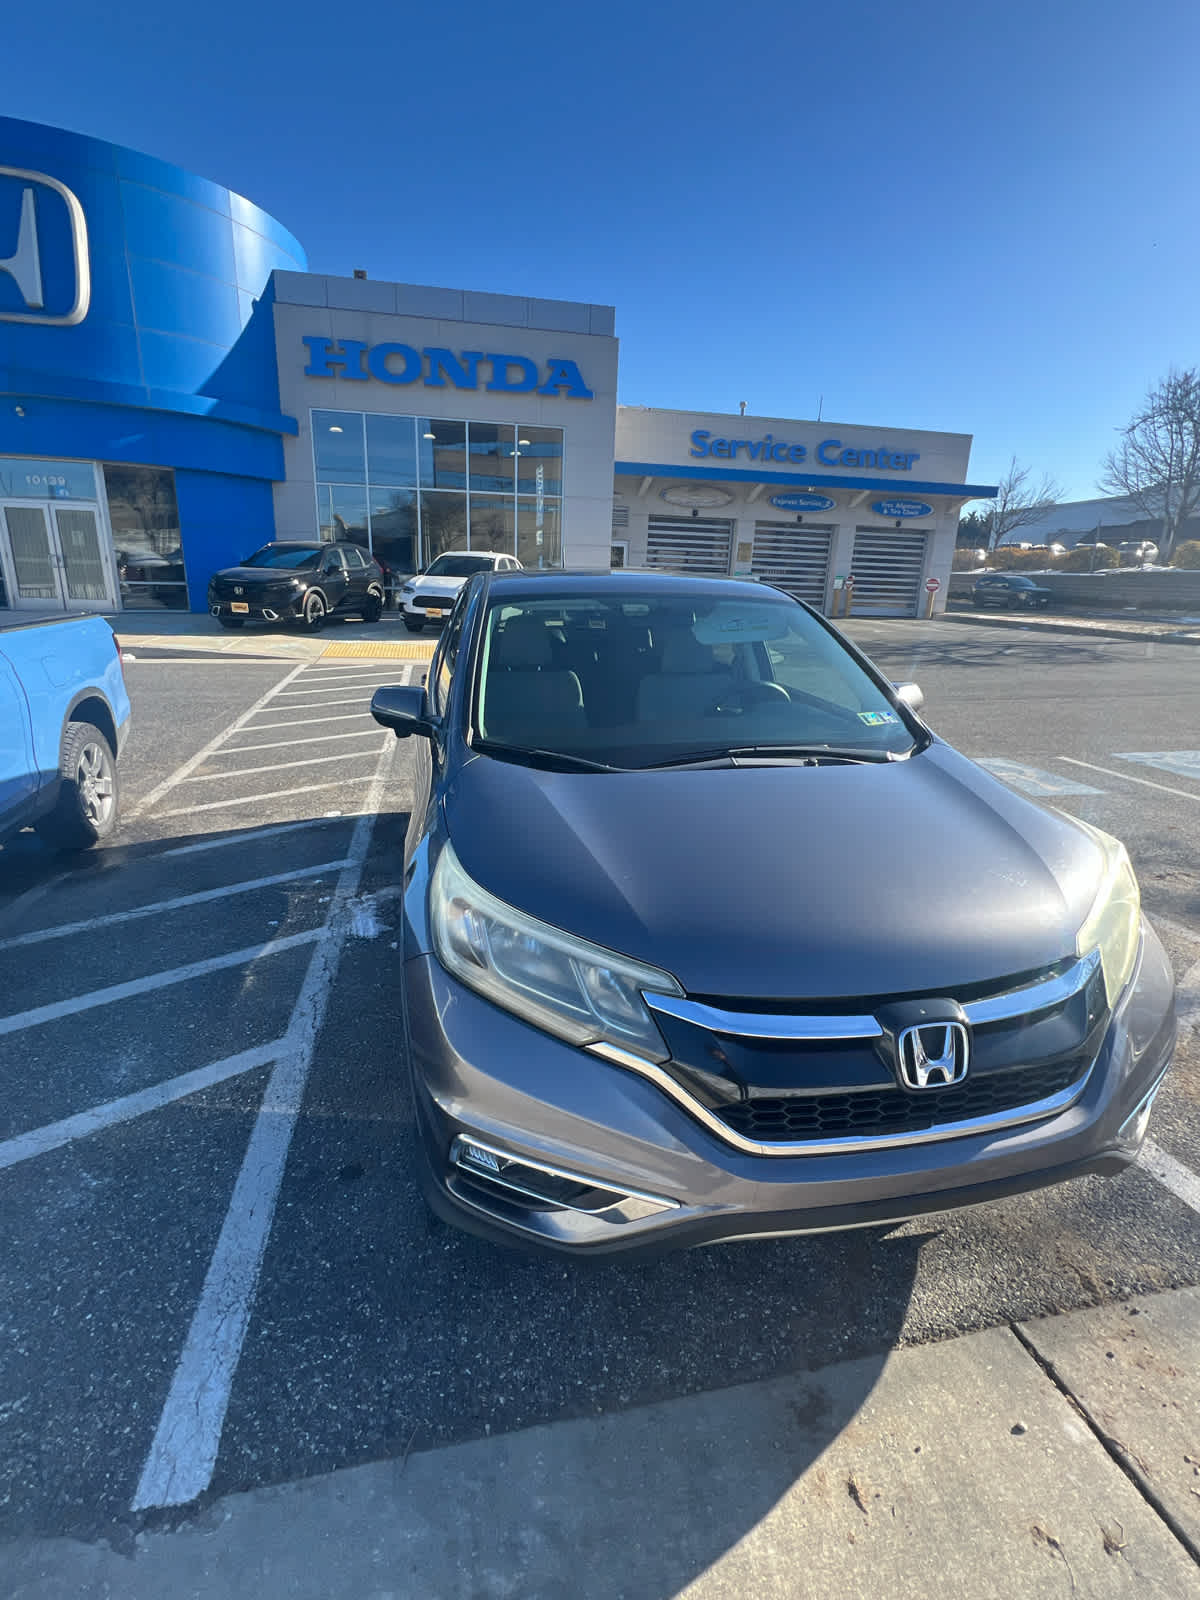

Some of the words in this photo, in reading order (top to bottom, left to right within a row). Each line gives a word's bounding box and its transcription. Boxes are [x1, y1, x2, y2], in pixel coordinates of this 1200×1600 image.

[302, 336, 594, 400] HONDA
[690, 430, 808, 463] Service
[816, 440, 920, 470] Center
